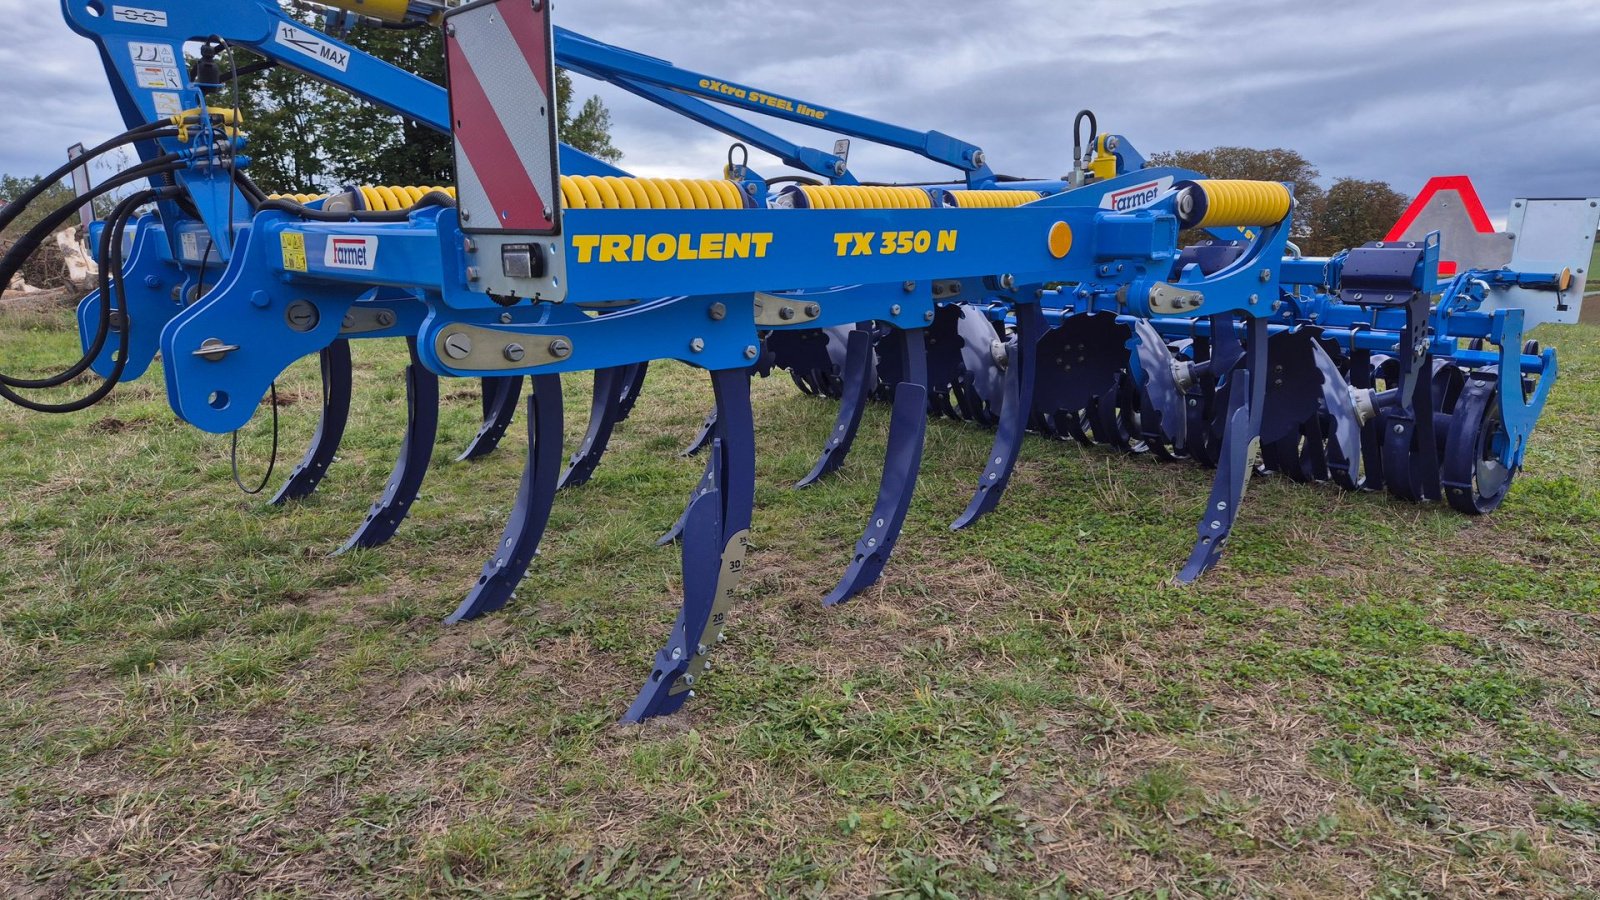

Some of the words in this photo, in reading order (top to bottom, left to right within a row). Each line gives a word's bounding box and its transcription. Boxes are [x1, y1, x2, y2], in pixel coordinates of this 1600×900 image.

[320, 46, 346, 66] MAX
[699, 79, 746, 98] eXtra
[748, 91, 793, 111] STEEL
[1111, 182, 1158, 211] Farmet
[333, 239, 367, 265] Farmet
[572, 232, 773, 263] TRIOLENT
[833, 232, 875, 256] TX
[879, 230, 931, 254] 350
[936, 230, 957, 252] N
[729, 559, 741, 570] 30
[712, 612, 724, 623] 20
